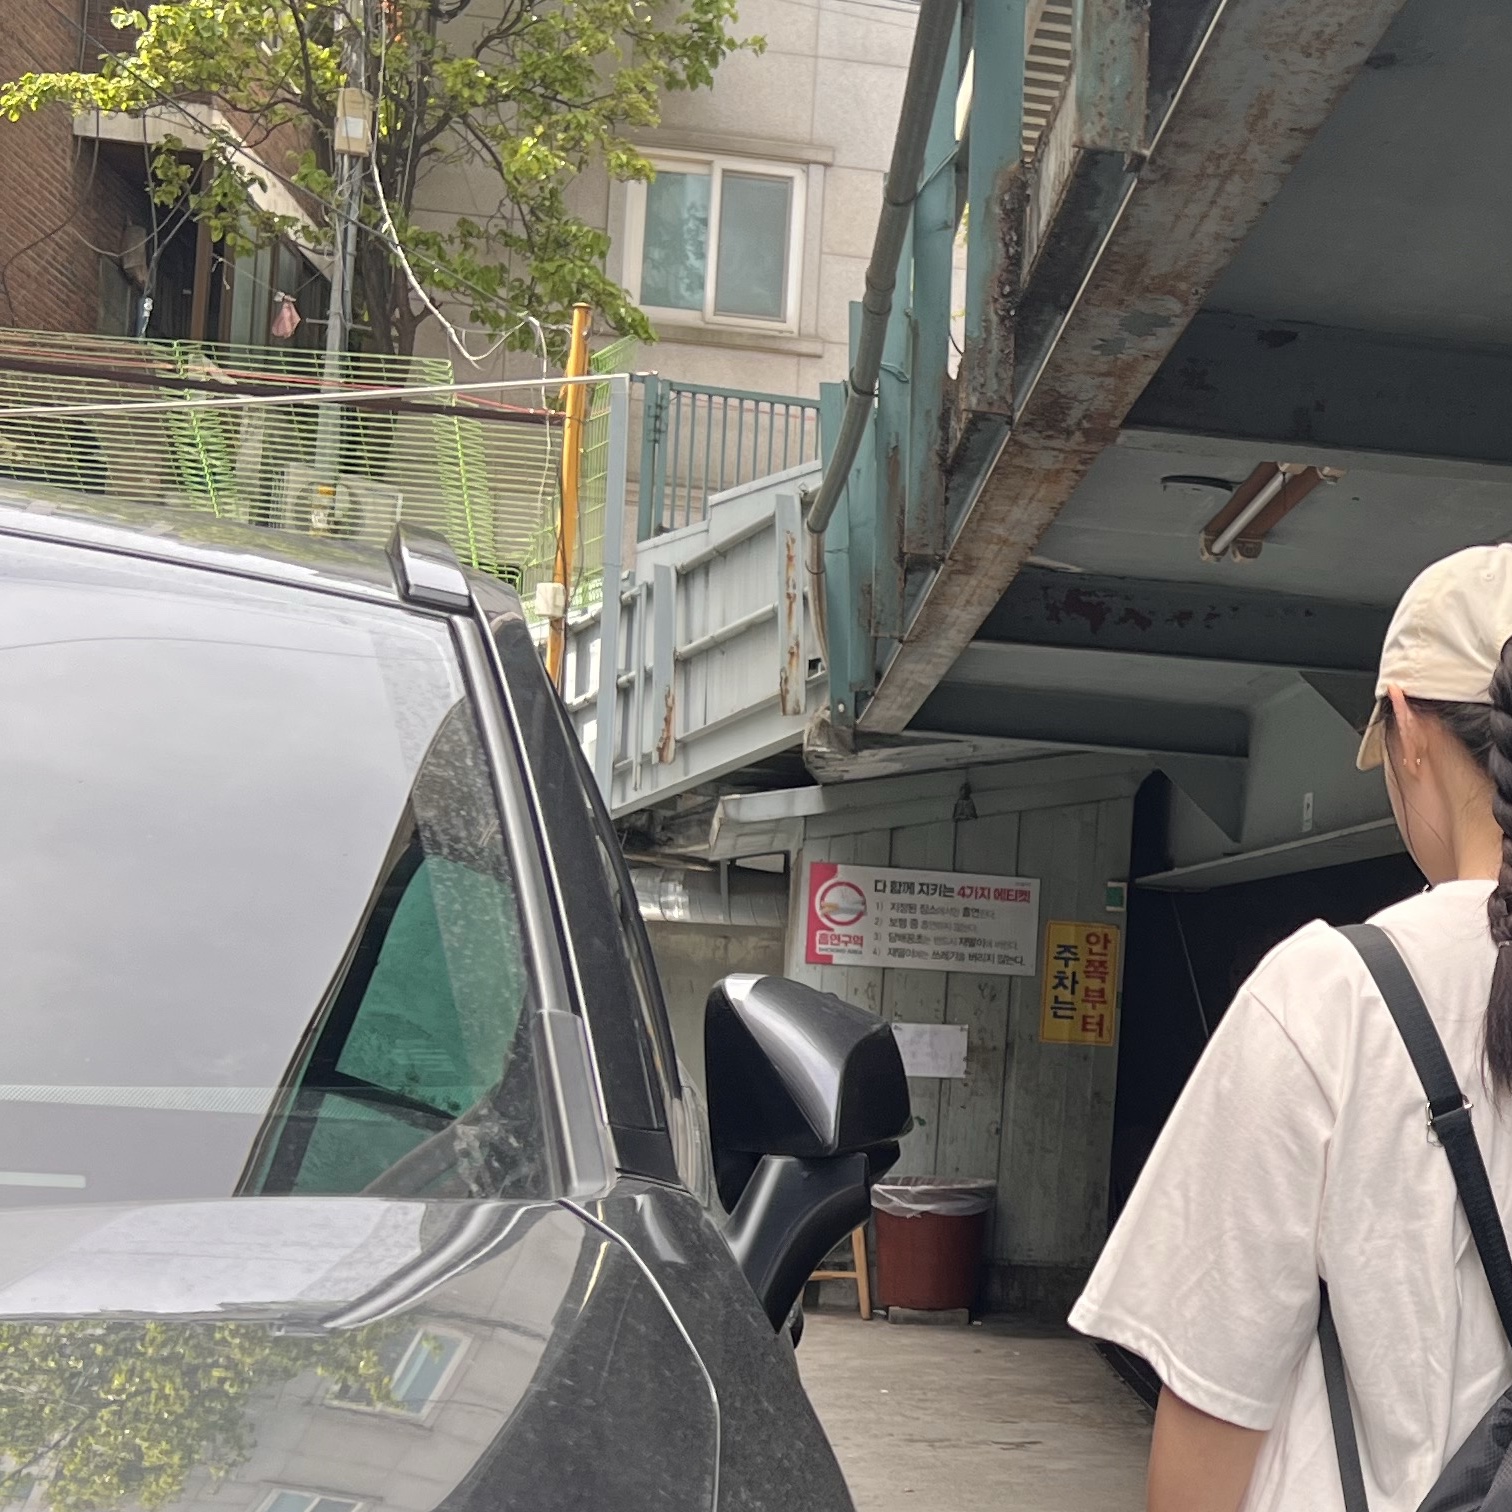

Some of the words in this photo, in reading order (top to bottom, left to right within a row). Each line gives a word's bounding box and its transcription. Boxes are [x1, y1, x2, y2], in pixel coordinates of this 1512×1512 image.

[890, 880, 915, 896] 함께
[917, 882, 955, 898] 지키는
[957, 885, 991, 900] 4가지
[993, 888, 1031, 904] 에티켓
[818, 933, 864, 949] 흡연구역
[1050, 944, 1080, 1020] 주차는
[1080, 931, 1111, 1038] 안쪽부터
